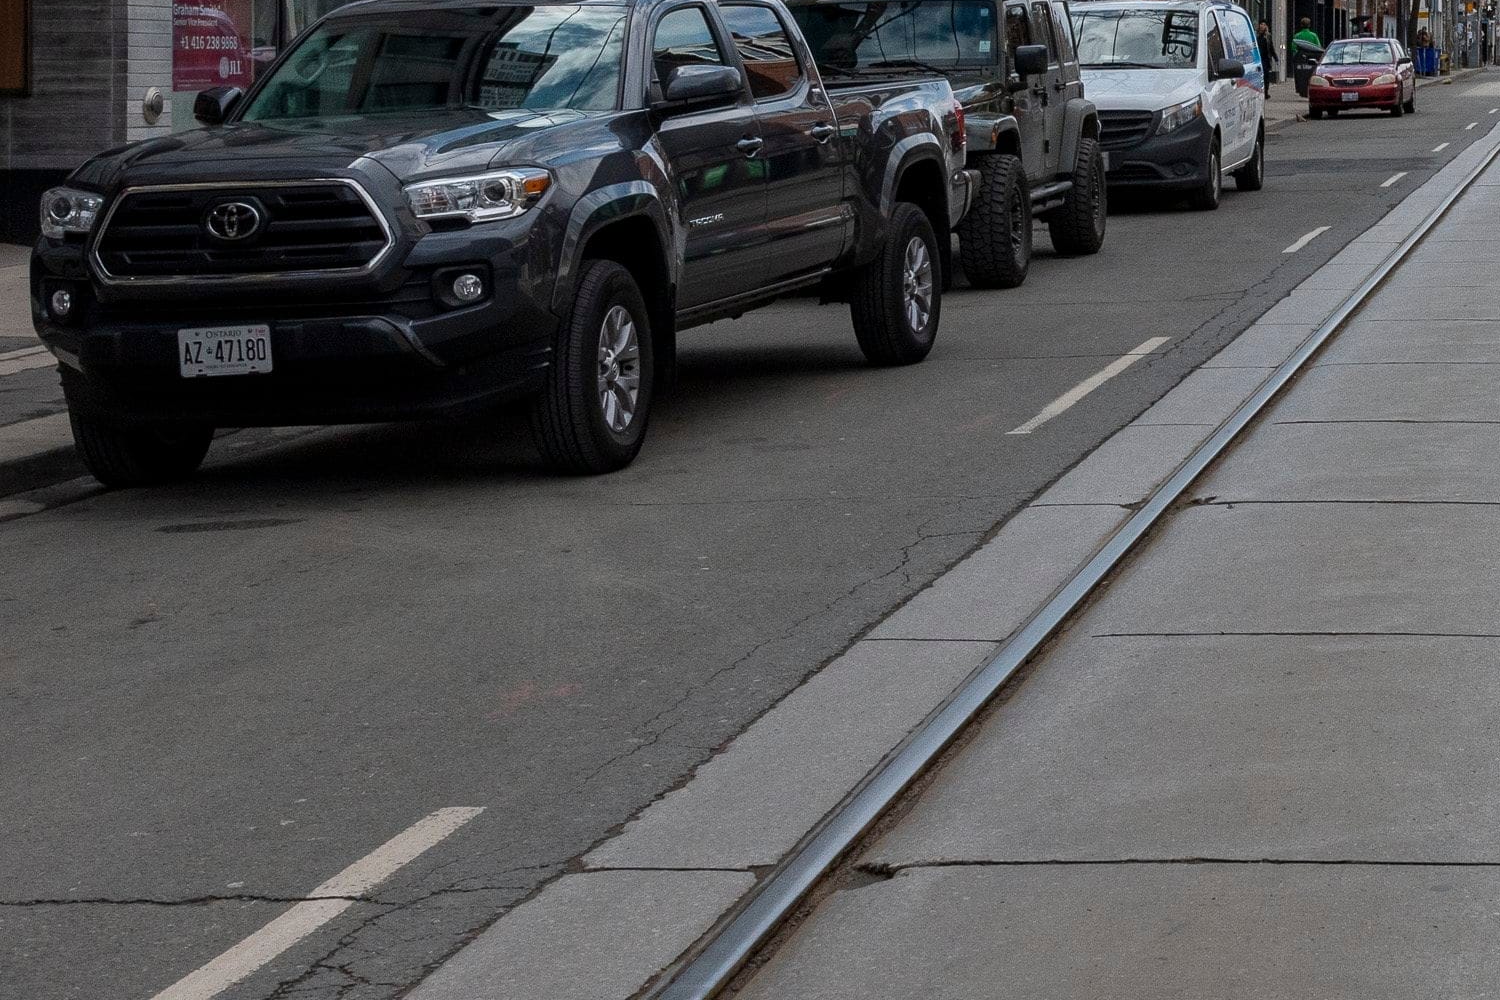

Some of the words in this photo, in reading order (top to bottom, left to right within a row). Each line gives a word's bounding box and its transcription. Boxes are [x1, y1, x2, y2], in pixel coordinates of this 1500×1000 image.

[190, 34, 205, 49] 416
[206, 35, 220, 50] 238
[205, 329, 242, 339] ONTARIO
[183, 341, 204, 366] AZ
[215, 338, 267, 364] 47180
